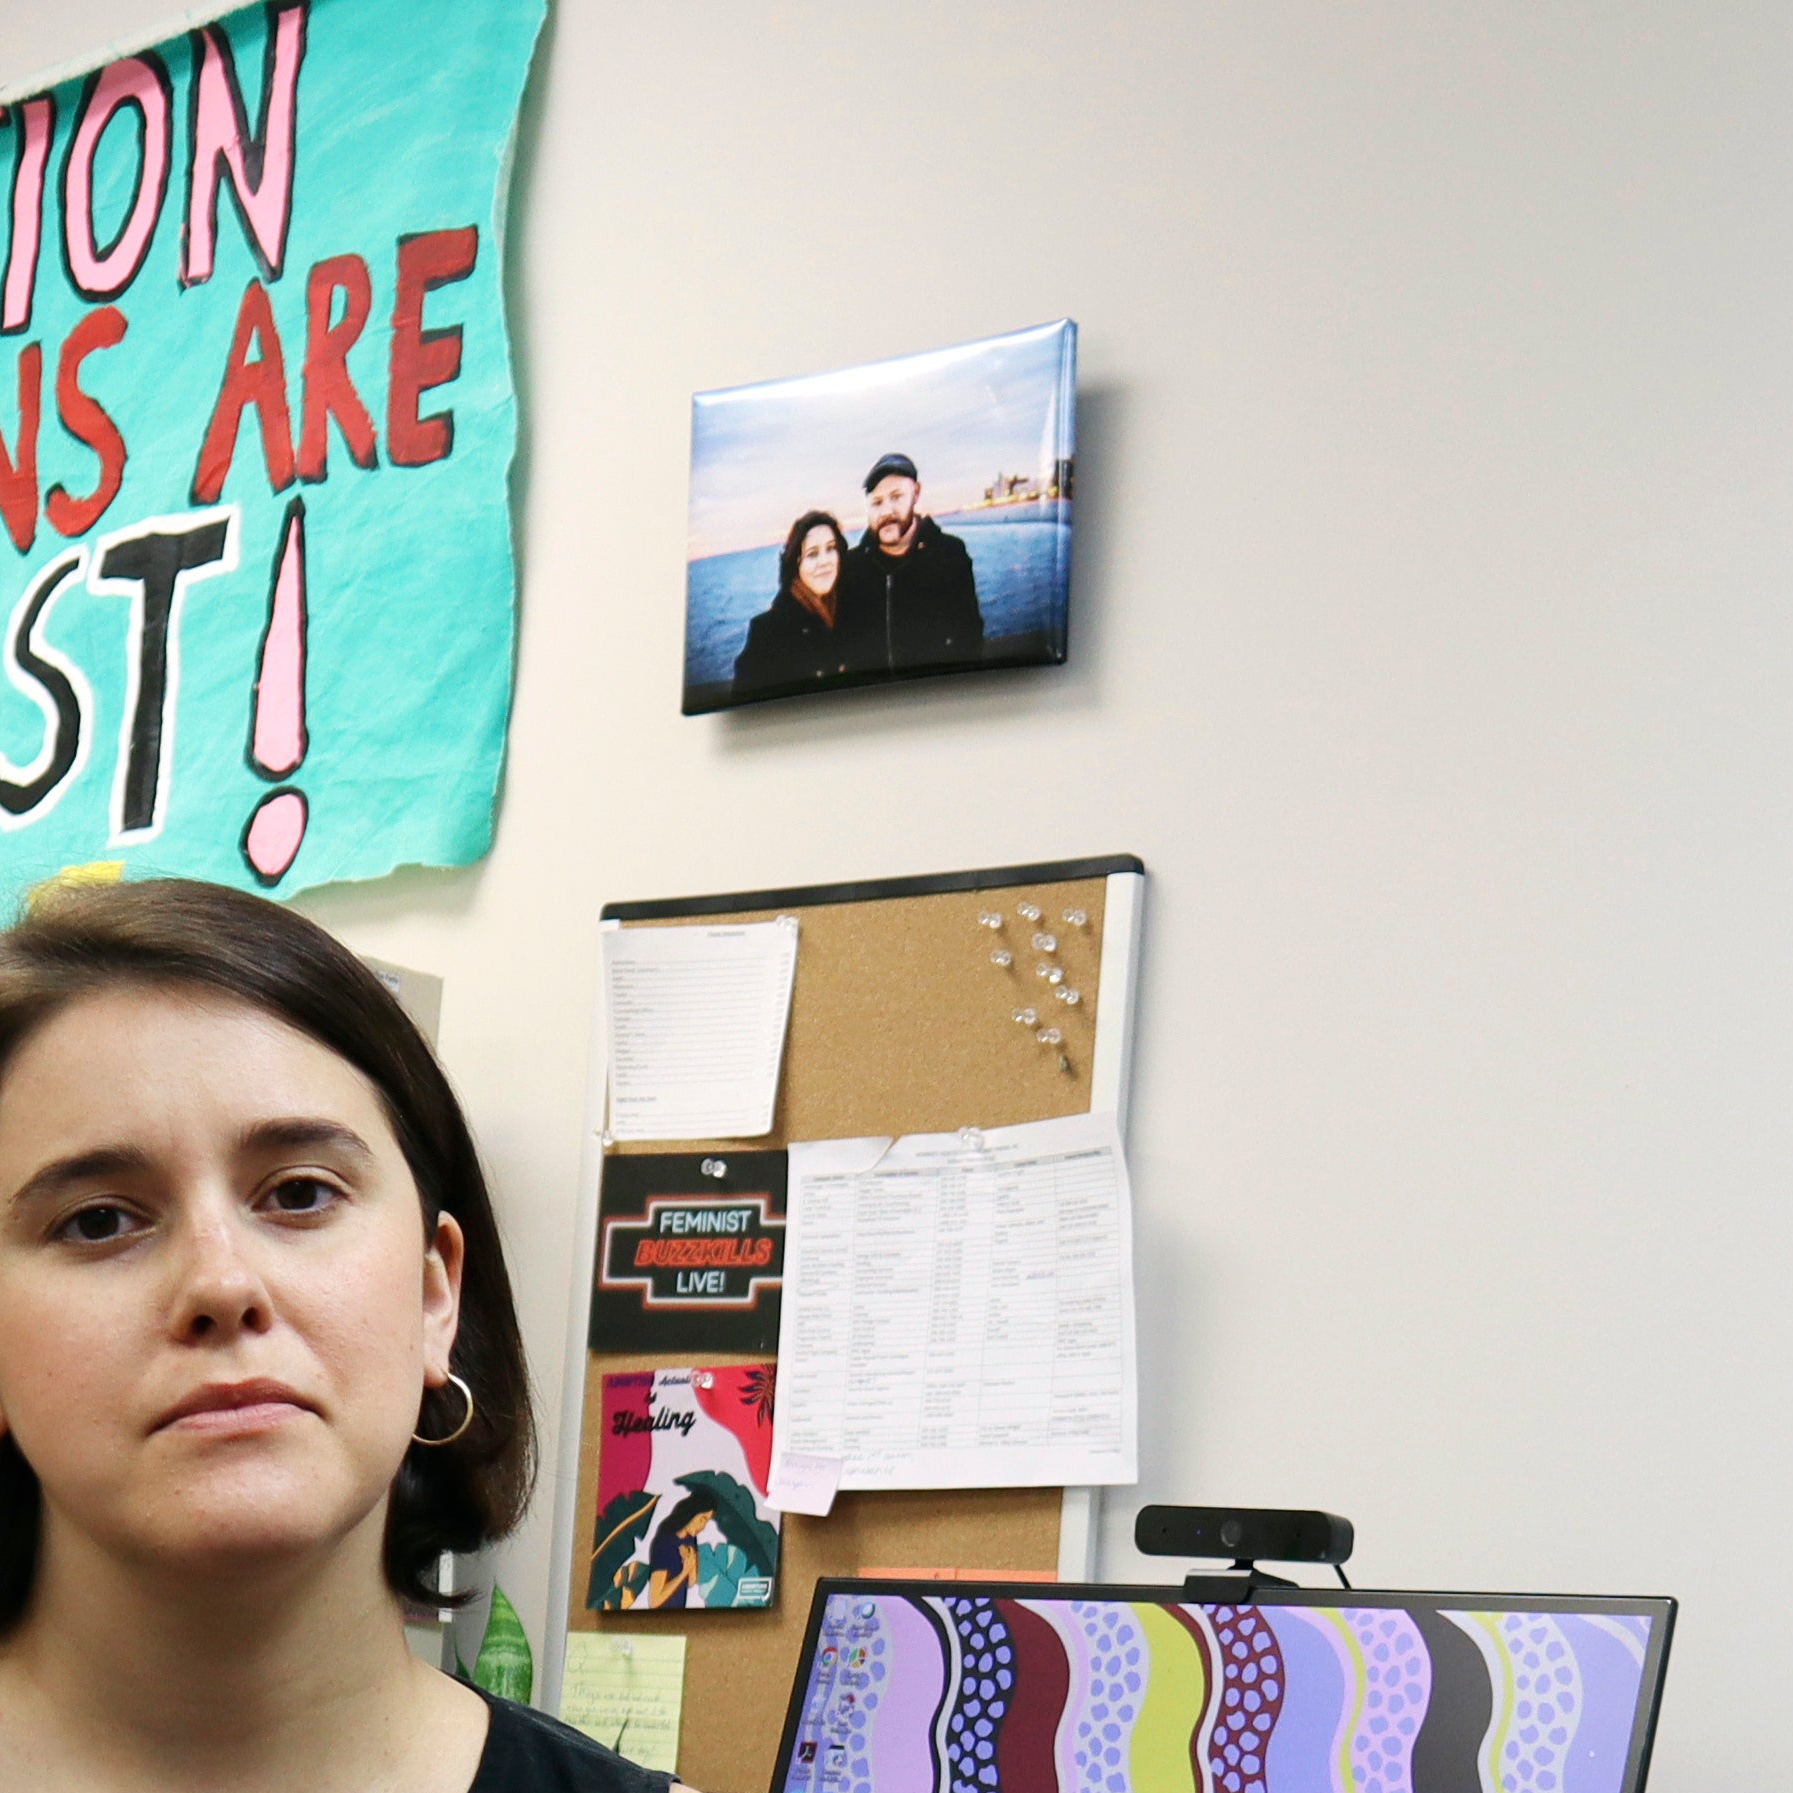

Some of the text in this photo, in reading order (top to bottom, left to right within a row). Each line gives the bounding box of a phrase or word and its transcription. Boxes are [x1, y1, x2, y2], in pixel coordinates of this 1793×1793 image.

[190, 225, 478, 506] ARE
[659, 1210, 753, 1234] FEMINIST
[634, 1238, 774, 1267] BUZZKILLS
[676, 1270, 726, 1294] LIVE!
[611, 1406, 697, 1438] Healing
